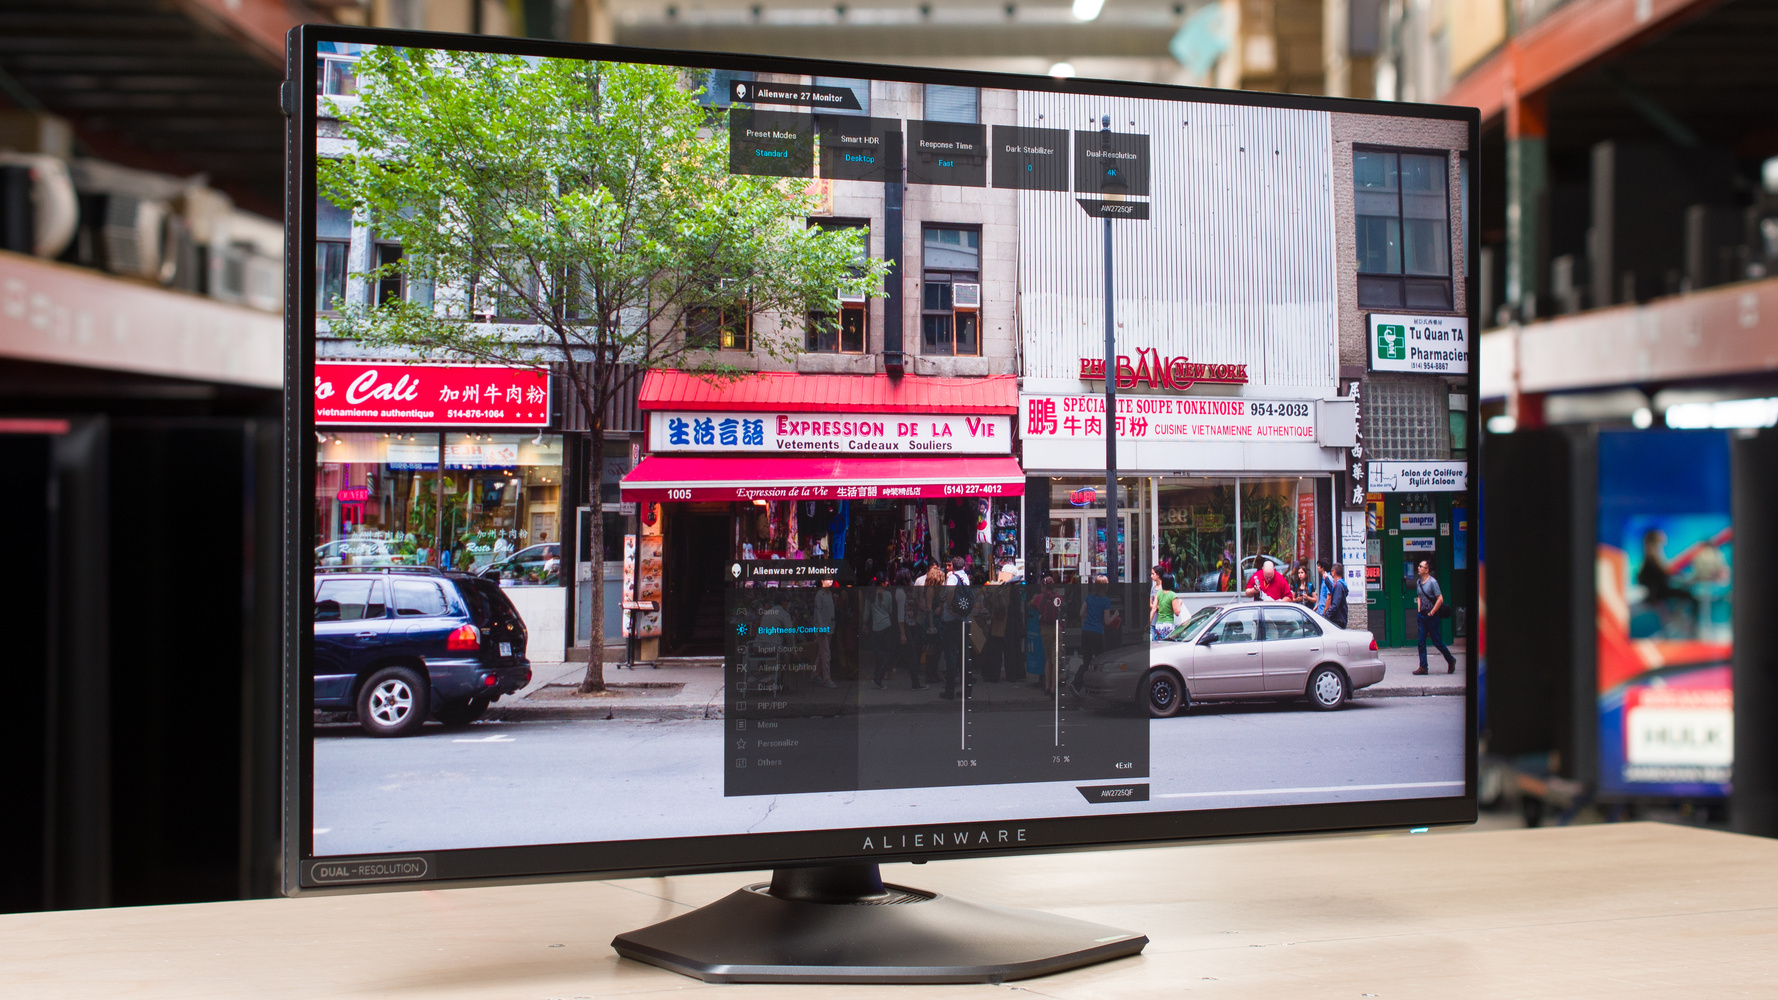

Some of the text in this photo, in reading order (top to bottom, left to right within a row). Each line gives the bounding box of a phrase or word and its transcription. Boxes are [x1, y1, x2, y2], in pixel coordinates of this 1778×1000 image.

[758, 89, 843, 102] Alienware 27 Monitor
[746, 129, 797, 139] Preset Modes
[840, 135, 880, 145] Smart HDR
[919, 139, 973, 150] Response Time
[755, 148, 789, 158] Standard
[1005, 145, 1054, 155] Dark Stabilizer
[1086, 150, 1137, 160] Dual-Resolution
[845, 153, 875, 164] Desktop
[938, 159, 954, 168] Fast
[1027, 164, 1033, 172] 0
[1106, 169, 1117, 177] 4K
[1100, 204, 1134, 214] AW2725QF
[1410, 326, 1464, 342] Tu Quan TA
[1174, 362, 1206, 378] NEW
[1207, 363, 1249, 379] YORK
[1411, 362, 1423, 370] (514)
[345, 369, 420, 405] Cali
[438, 383, 547, 405] 加州牛肉粉
[1063, 395, 1309, 417] SPÉCIAITE SOUPE TONKINOISE 954-2032
[316, 408, 505, 420] vietnamienne authentique 514-876-1064
[668, 417, 764, 446] 生活言語
[775, 415, 885, 437] EXPRESSION
[896, 422, 919, 437] DE
[931, 422, 953, 438] LA
[1154, 424, 1313, 438] CUISINE VIETNAMIENNE AUTHENTIQUE
[776, 439, 953, 450] Vetements Cadeaux Souliers
[1401, 468, 1463, 477] Salon de Coiffure
[1409, 477, 1456, 488] Stylist Saloon
[667, 489, 692, 500] 1005
[736, 485, 829, 500] Expression de la Vie
[943, 484, 1002, 496] (514) 227-4012
[1070, 490, 1097, 503] OUVERT
[1408, 516, 1435, 526] uniprix
[466, 542, 491, 553] Resto
[1411, 540, 1433, 548] uniprix
[753, 565, 839, 576] Alienware 27 Monitor
[758, 607, 780, 616] Game
[757, 625, 831, 636] Brightness/Contrast
[757, 645, 804, 655] Input Source
[758, 663, 787, 672] AlienFX
[788, 662, 817, 673] Lighting
[757, 682, 785, 692] Display
[757, 701, 788, 711] PIP/PBP
[757, 720, 779, 729] Menu
[757, 739, 799, 748] Personalize
[757, 758, 783, 767] Others
[956, 759, 977, 767] 100 %
[1052, 755, 1071, 763] 75 %
[1118, 761, 1133, 770] Exit
[1100, 788, 1134, 798] AW2725QF
[862, 828, 1028, 850] ALIENWARE
